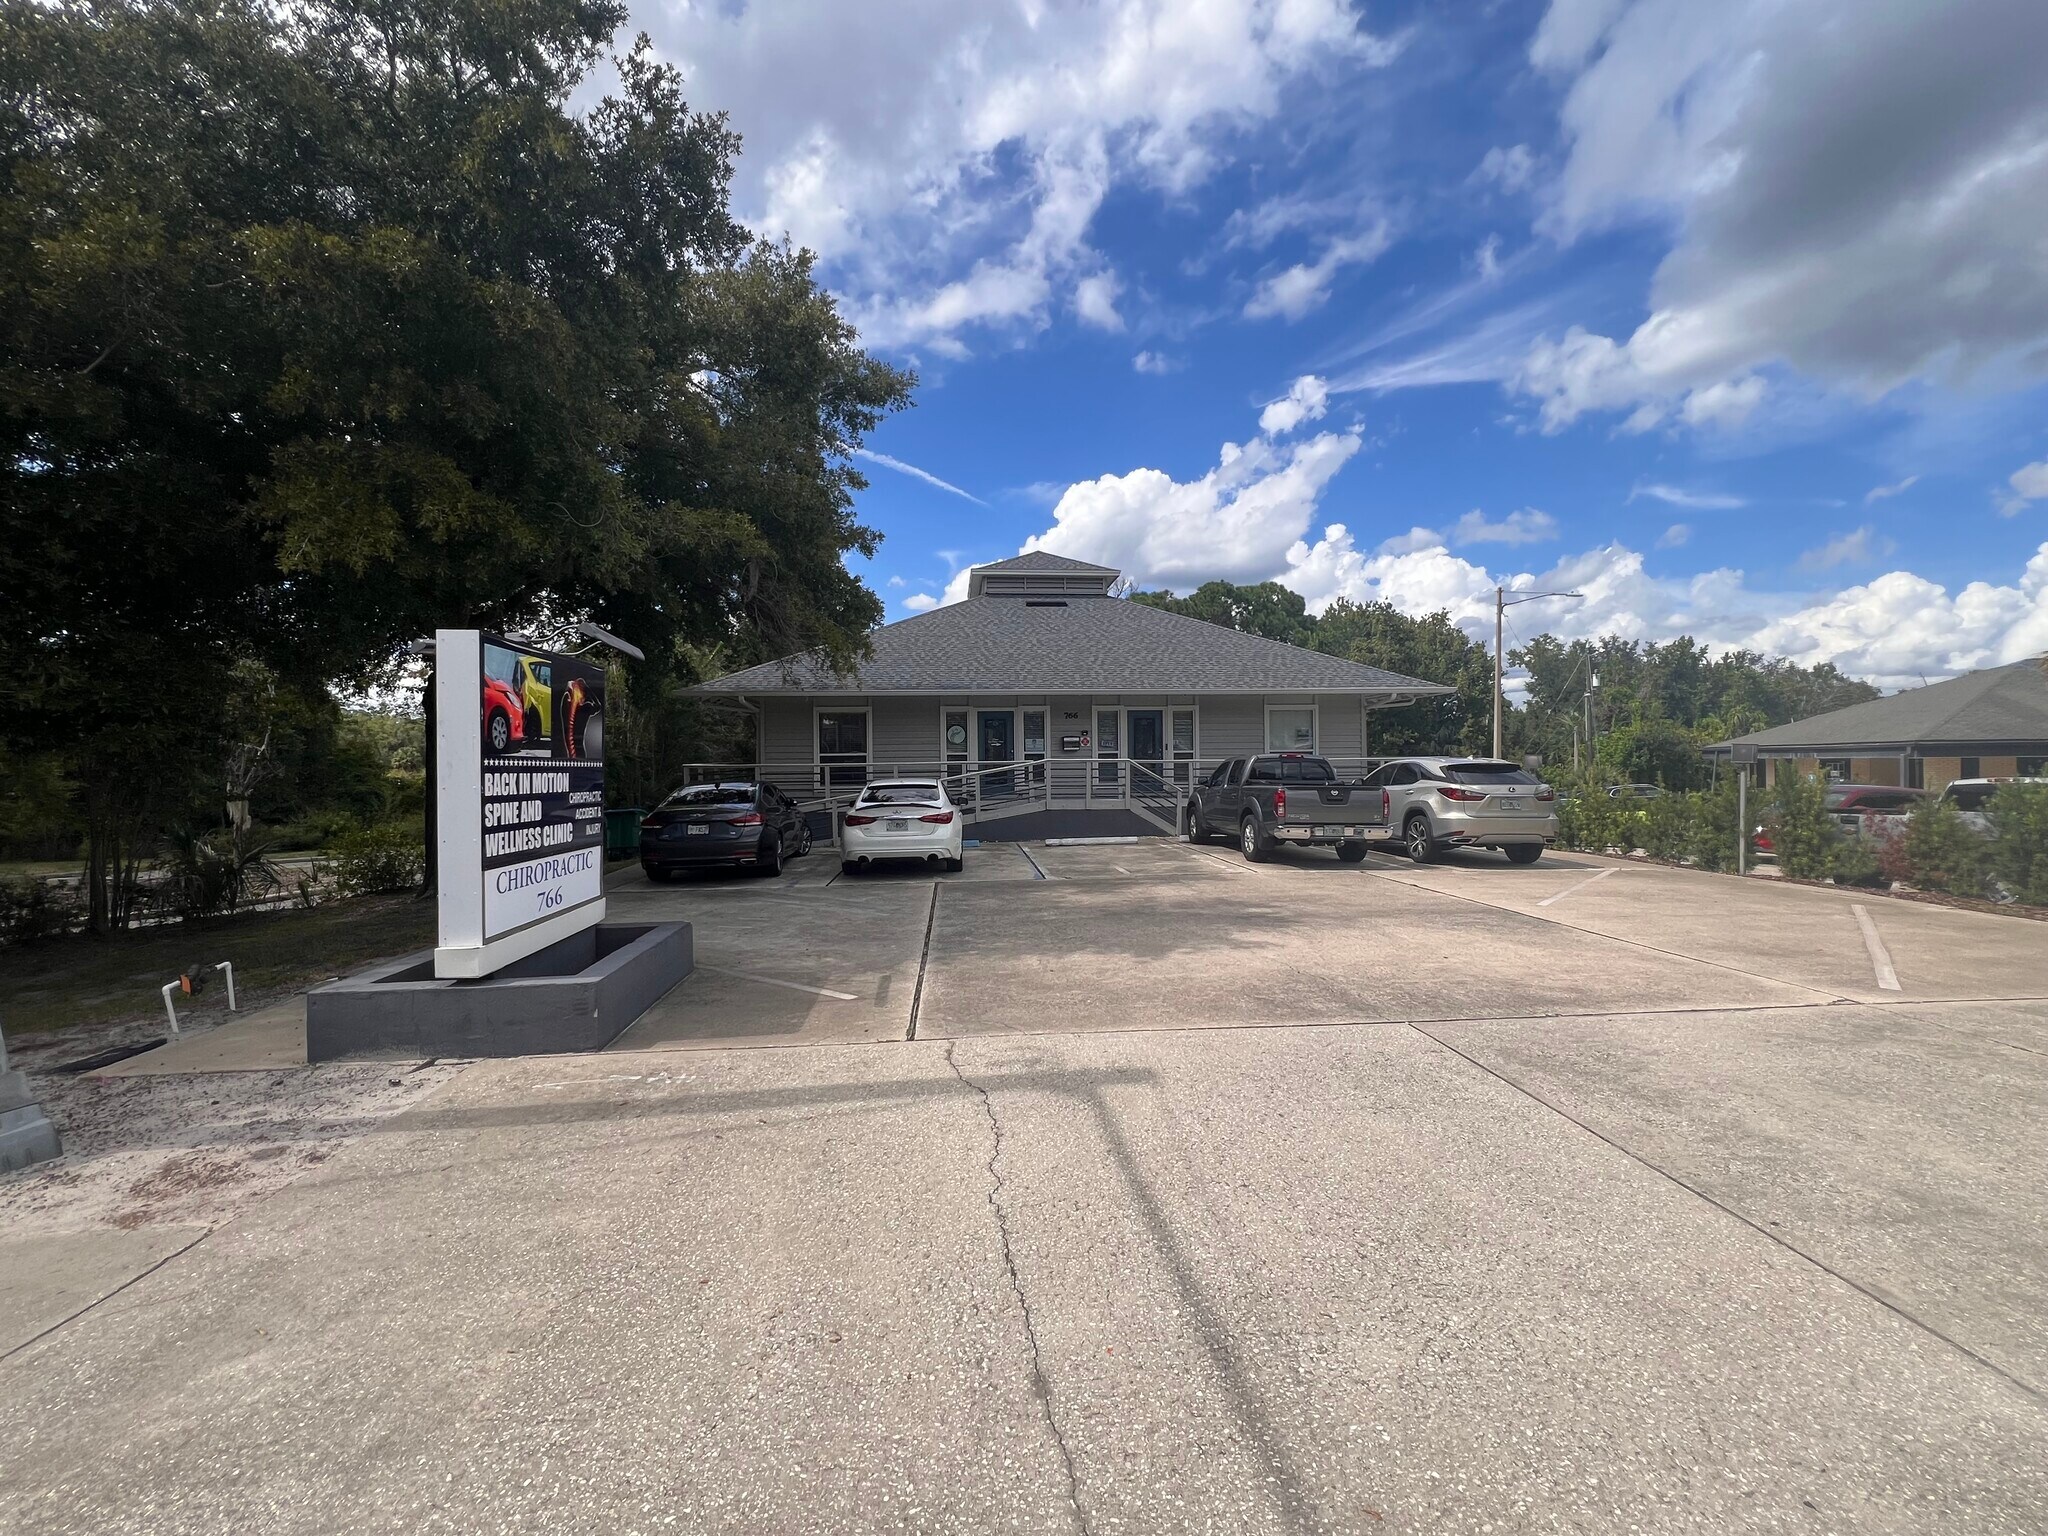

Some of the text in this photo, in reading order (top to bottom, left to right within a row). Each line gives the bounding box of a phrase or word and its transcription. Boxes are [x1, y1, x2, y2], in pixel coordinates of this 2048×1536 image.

[484, 772, 569, 796] BACK IN MOTION
[569, 791, 602, 804] CHIROPRACTIC
[484, 800, 542, 827] SPINE AND
[575, 807, 597, 819] ACCIDENT
[485, 822, 573, 857] WELLNESS CLINIC
[585, 823, 601, 835] INJURY
[496, 850, 593, 894] CHIROPRACTIC
[537, 886, 563, 912] 766
